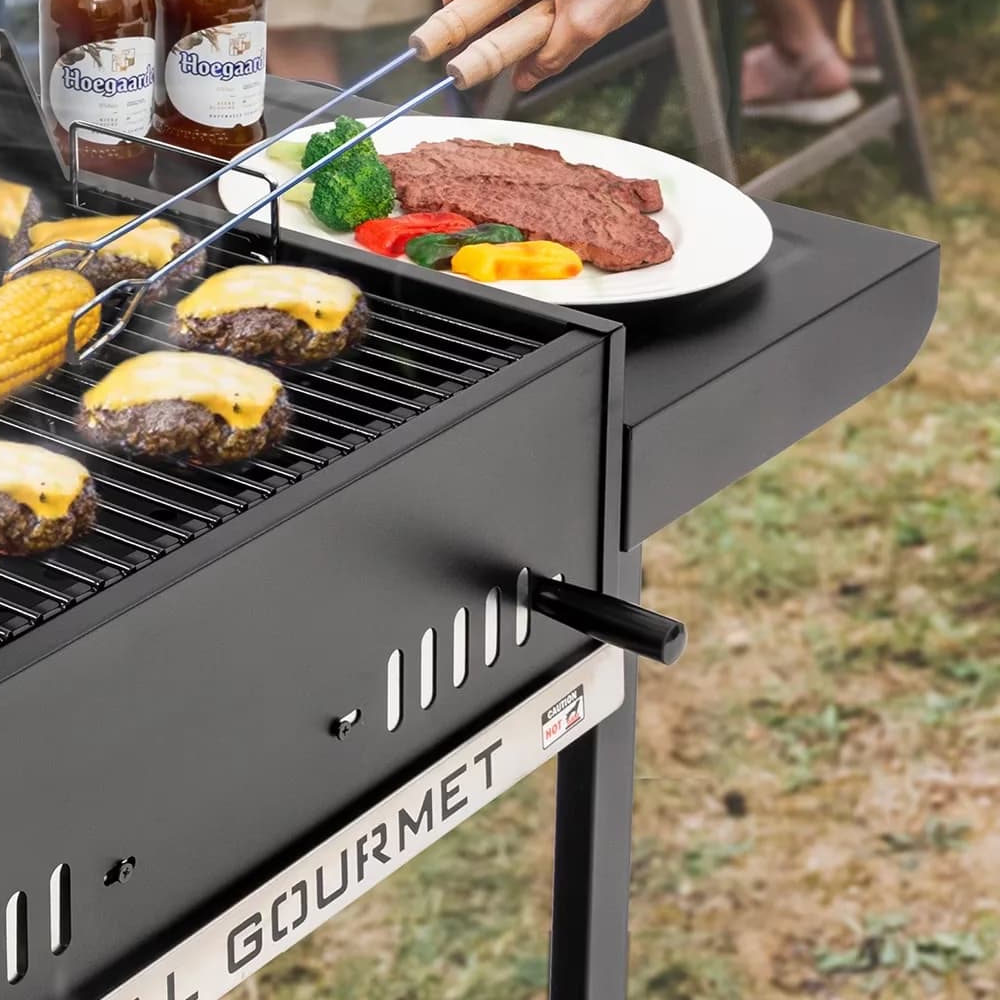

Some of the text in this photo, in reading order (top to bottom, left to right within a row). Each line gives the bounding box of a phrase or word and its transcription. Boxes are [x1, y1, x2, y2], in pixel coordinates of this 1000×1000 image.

[547, 690, 578, 719] CAUTION
[545, 720, 562, 740] HOT
[226, 738, 503, 974] GOURMET
